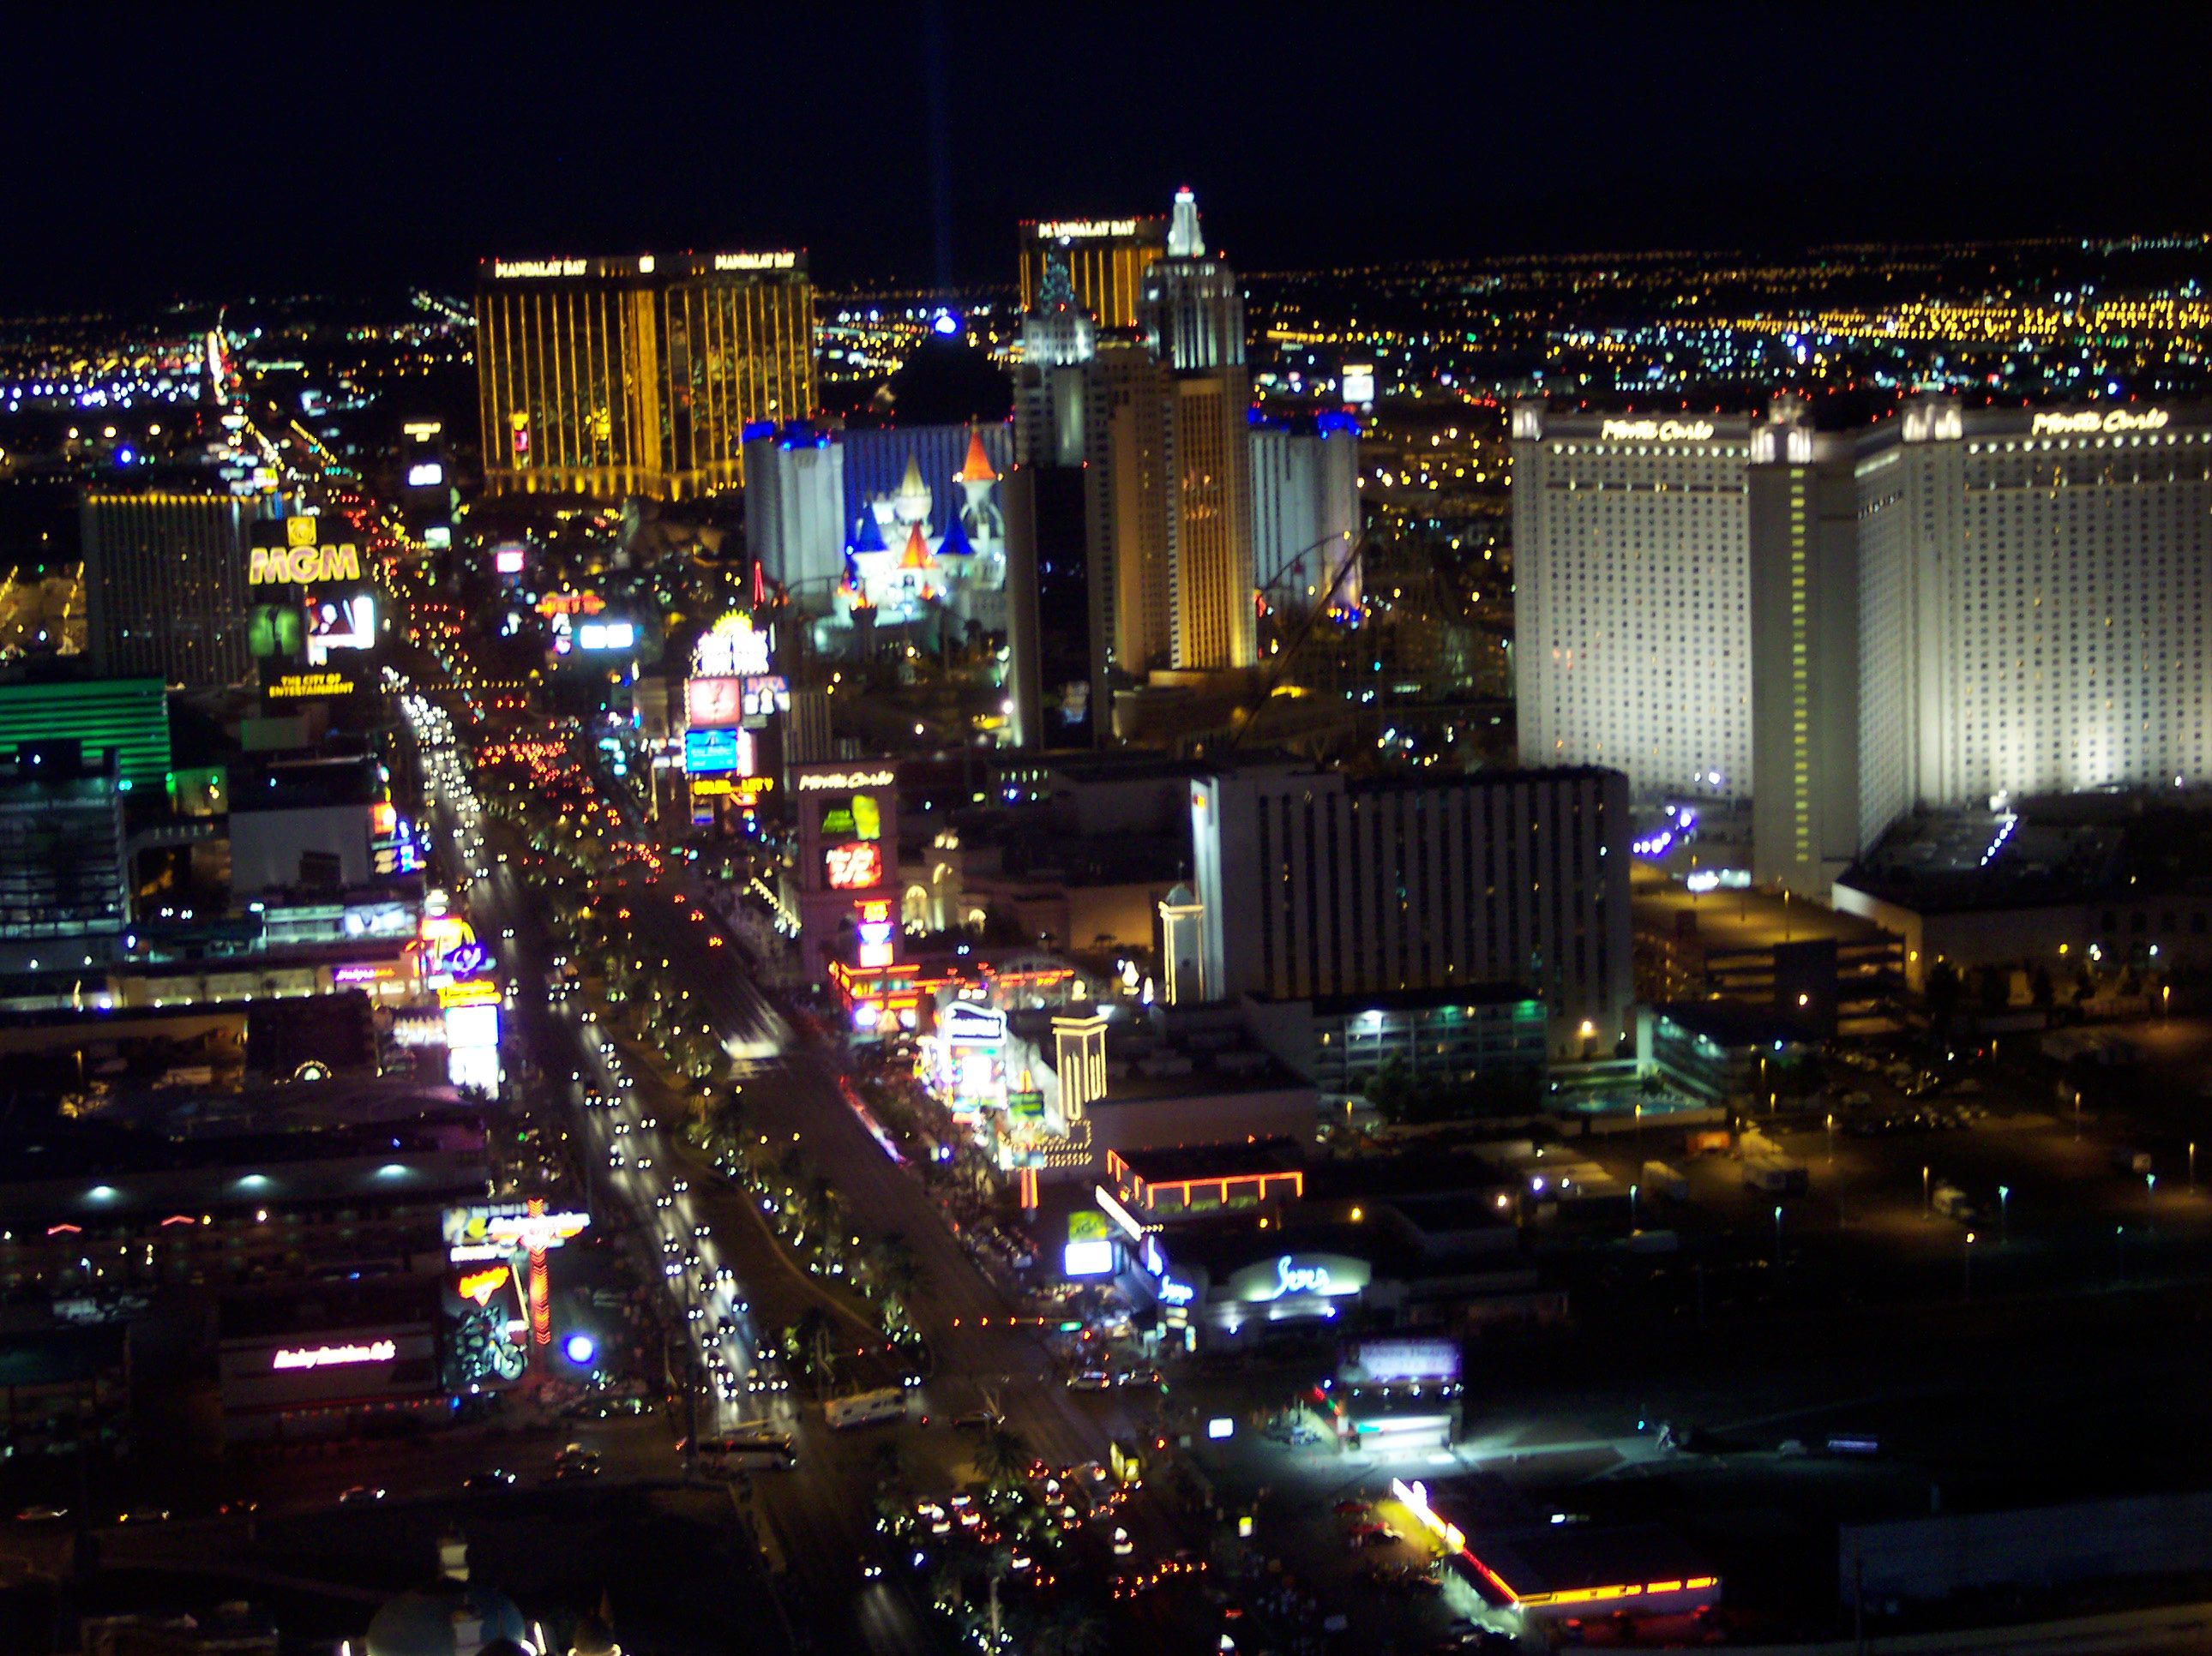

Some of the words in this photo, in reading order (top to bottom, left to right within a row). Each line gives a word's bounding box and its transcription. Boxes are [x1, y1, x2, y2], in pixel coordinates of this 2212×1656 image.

[249, 544, 361, 585] MGM
[281, 675, 302, 687] THE
[303, 674, 325, 686] CITY
